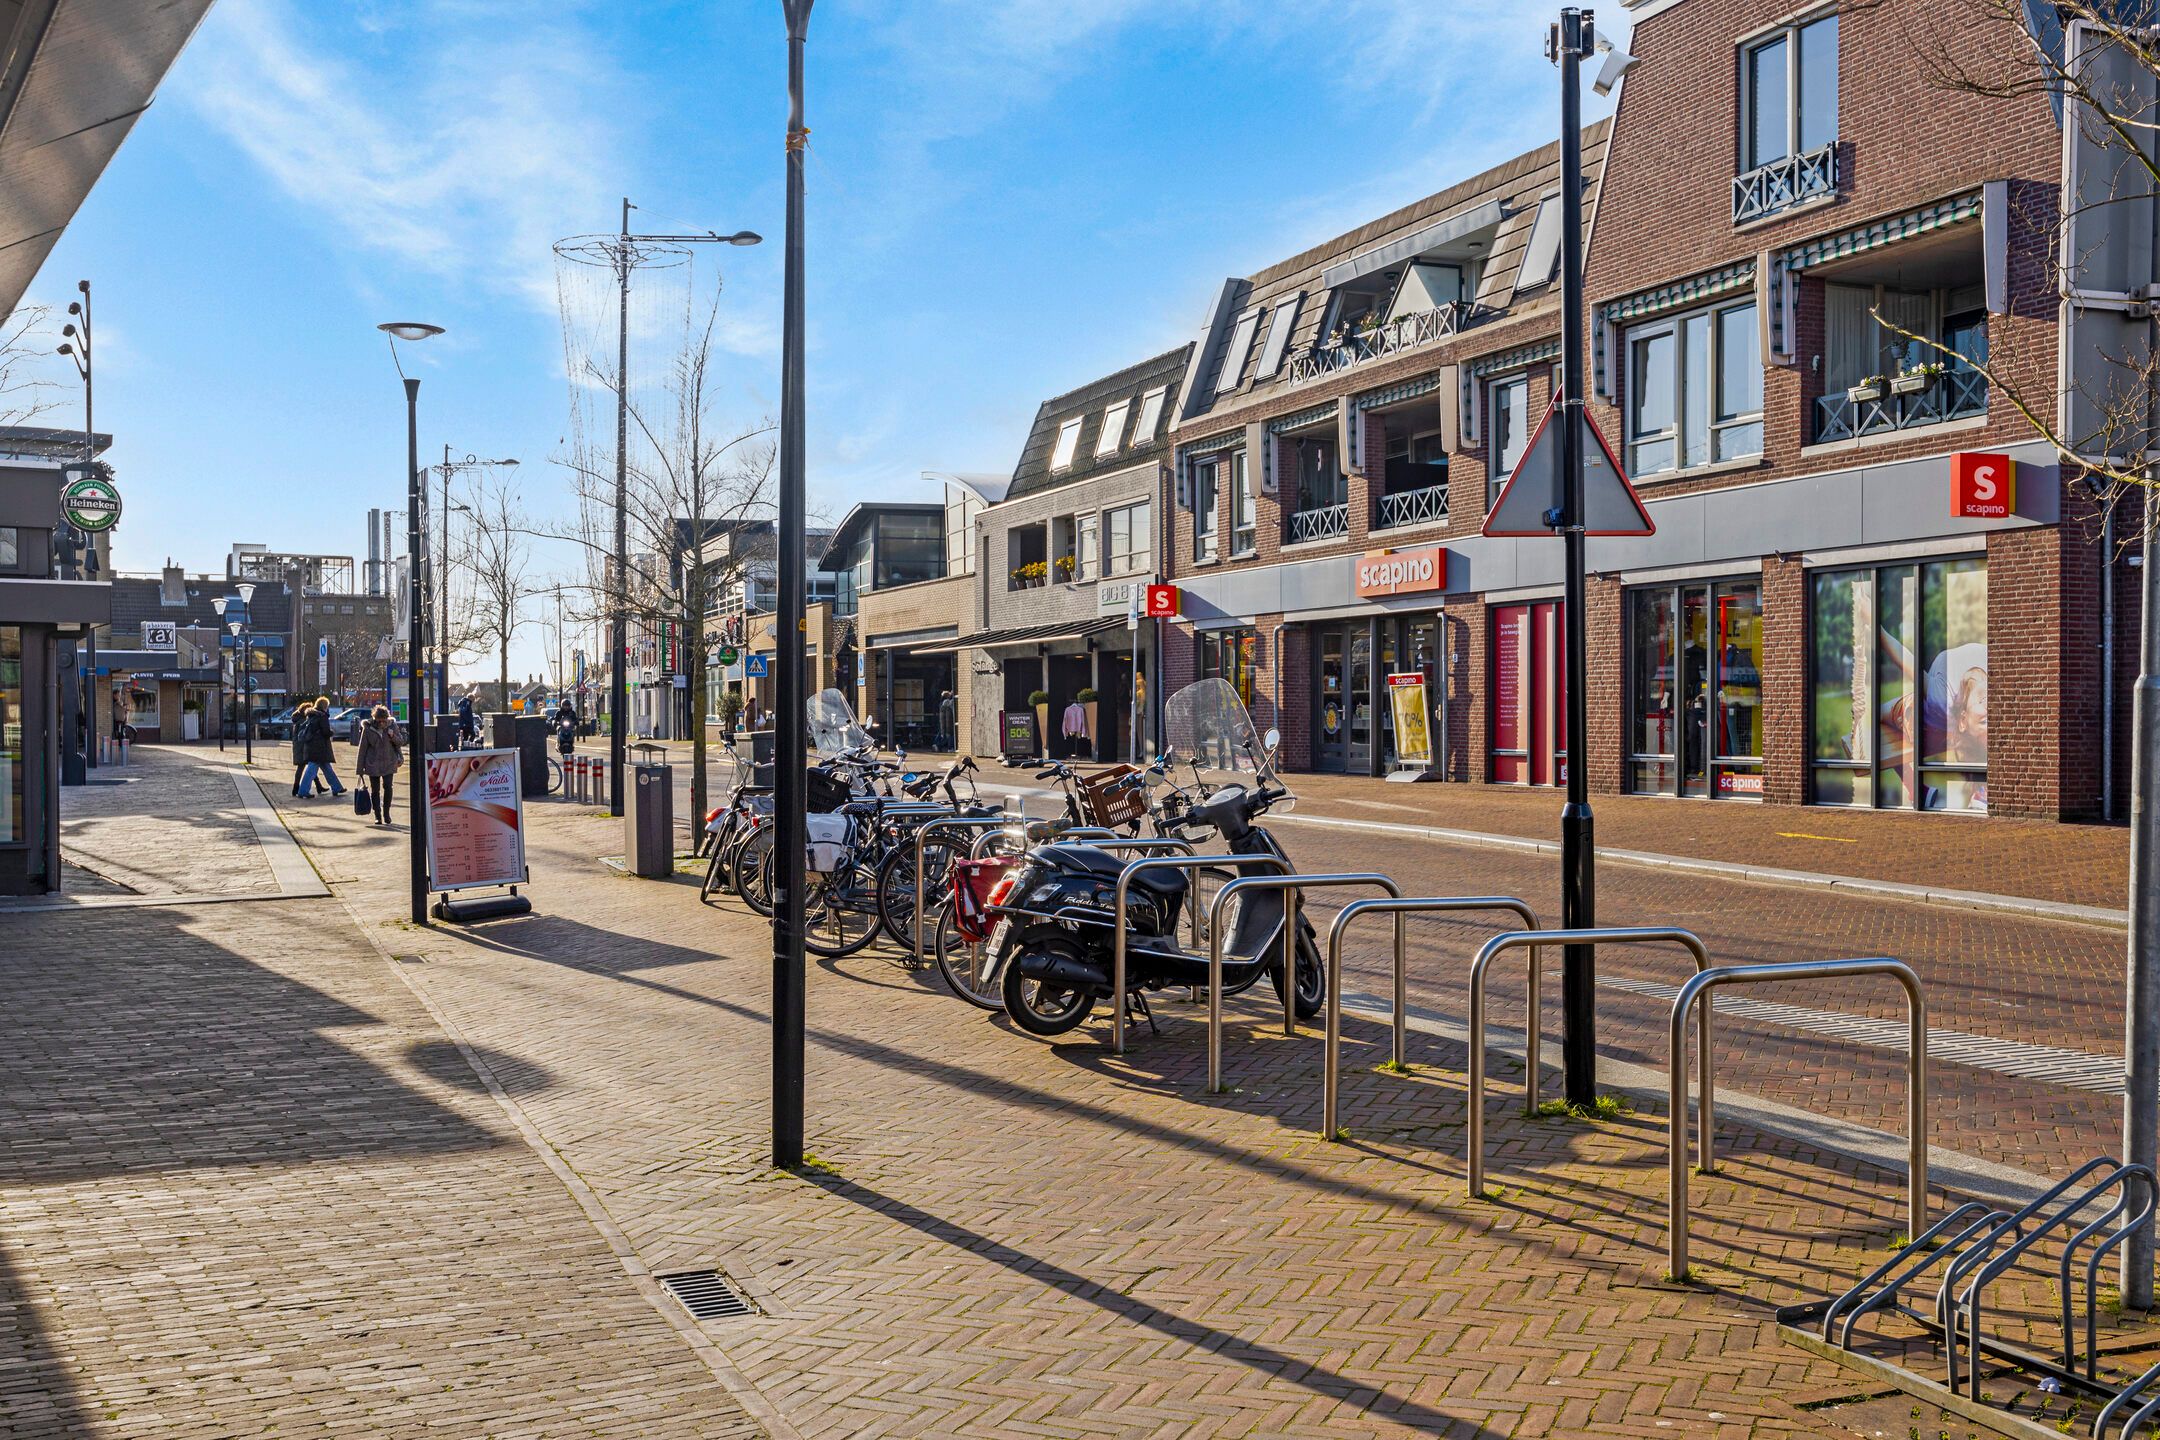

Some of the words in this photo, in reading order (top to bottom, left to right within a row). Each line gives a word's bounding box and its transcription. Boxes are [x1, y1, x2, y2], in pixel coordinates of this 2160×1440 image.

[1974, 466, 1996, 500] S
[70, 499, 115, 509] Heineken
[1966, 505, 2004, 516] scapino
[1360, 558, 1433, 593] scapino
[1102, 586, 1118, 602] BIG
[1155, 591, 1169, 608] S
[1395, 677, 1416, 685] scapino
[1010, 728, 1030, 738] 50%
[480, 774, 508, 787] Nails
[1720, 778, 1761, 791] scapino
